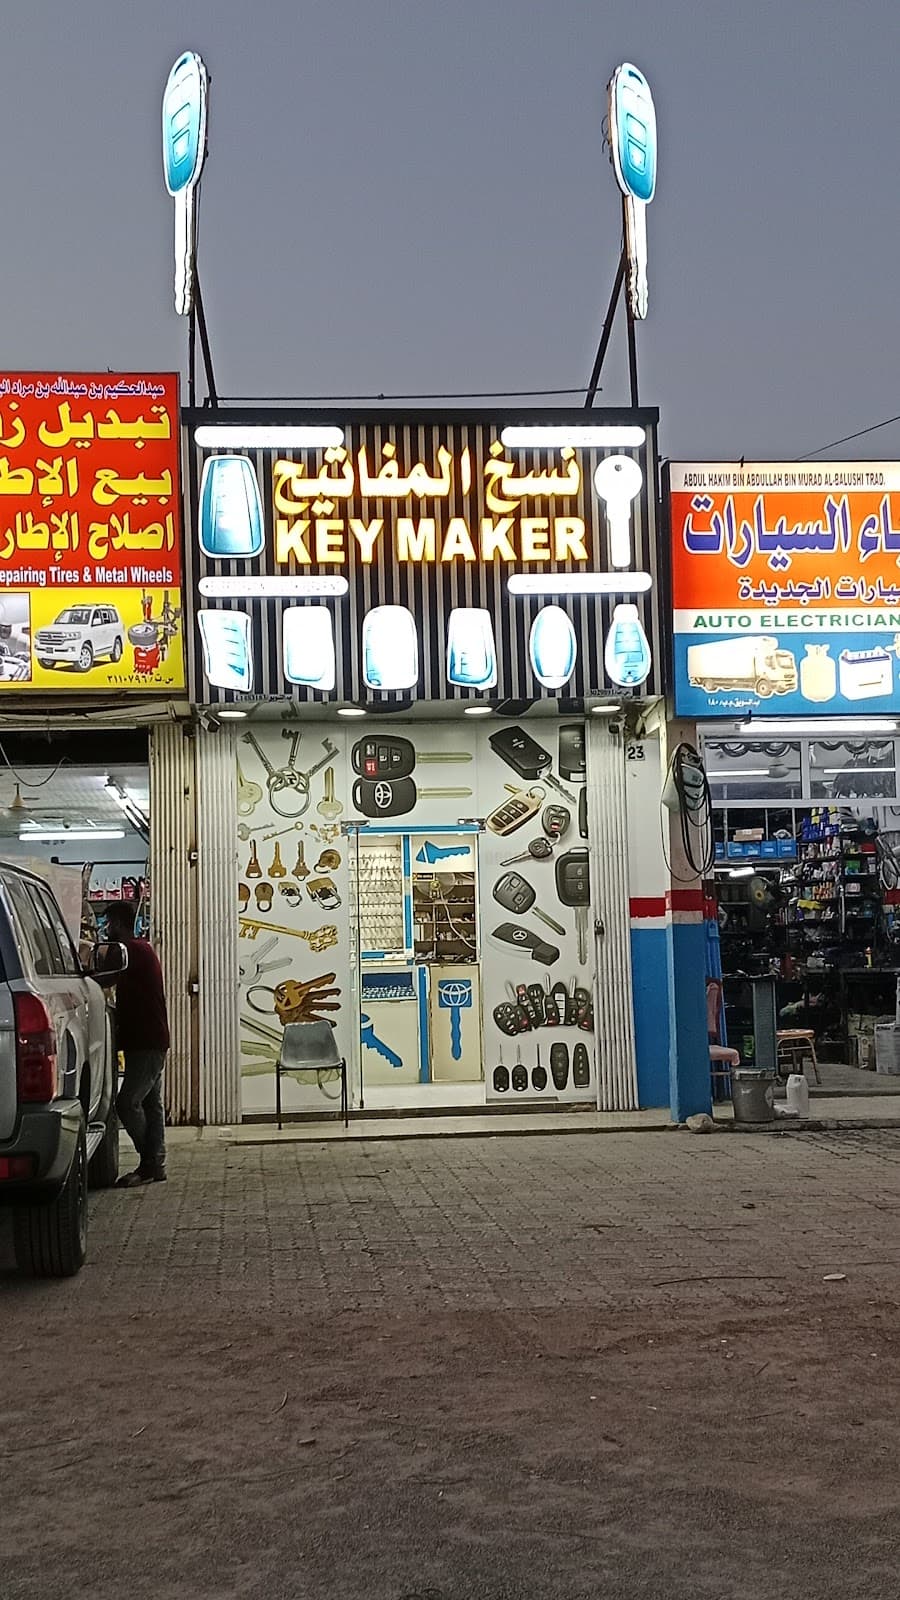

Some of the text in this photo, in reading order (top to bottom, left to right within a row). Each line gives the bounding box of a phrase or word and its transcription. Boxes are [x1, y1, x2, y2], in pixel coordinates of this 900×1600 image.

[12, 379, 34, 398] مراد
[35, 380, 50, 399] بن
[89, 381, 103, 399] بن
[38, 401, 171, 449] تبديل
[92, 468, 172, 506] بيع
[273, 440, 582, 517] نسخ المفاتيح
[684, 472, 886, 489] ABDUL HAKIM BIN ABDULLAH BIN MURAD AL-BALUSHI TRAD.
[88, 511, 175, 560] اصلاح
[275, 516, 589, 564] KEY MAKER
[683, 494, 852, 569] السيارات
[49, 566, 80, 583] Tires
[83, 566, 92, 583] &
[95, 566, 128, 583] Metal
[131, 566, 173, 583] Wheels
[738, 576, 831, 608] الجديدة
[693, 614, 900, 628] AUTO ELECTRICIAN
[627, 745, 644, 760] 23
